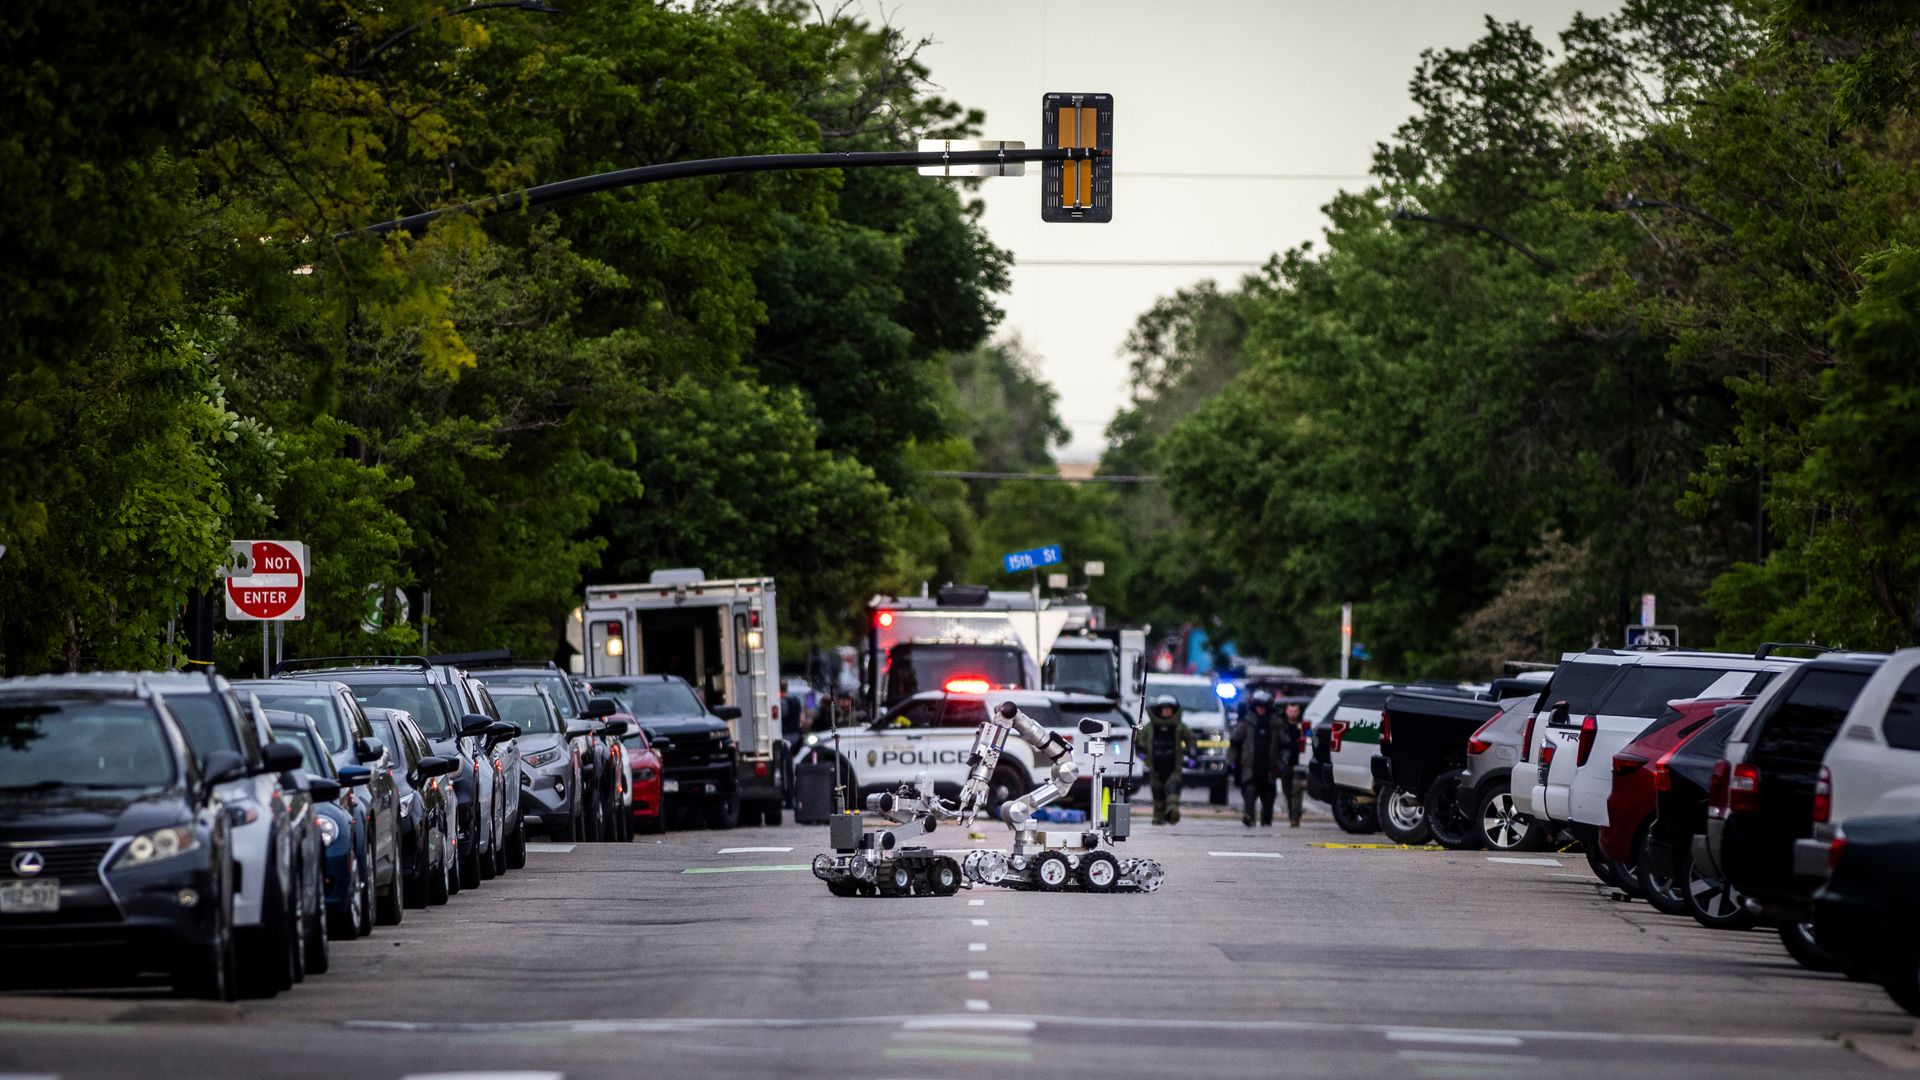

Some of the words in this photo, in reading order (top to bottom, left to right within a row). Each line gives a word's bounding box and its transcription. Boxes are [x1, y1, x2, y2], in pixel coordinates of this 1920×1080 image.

[265, 557, 291, 570] NOT
[1008, 554, 1033, 570] 15th
[1043, 548, 1057, 563] St
[244, 591, 287, 604] ENTER
[1559, 731, 1580, 743] TR
[882, 750, 970, 765] POLICE
